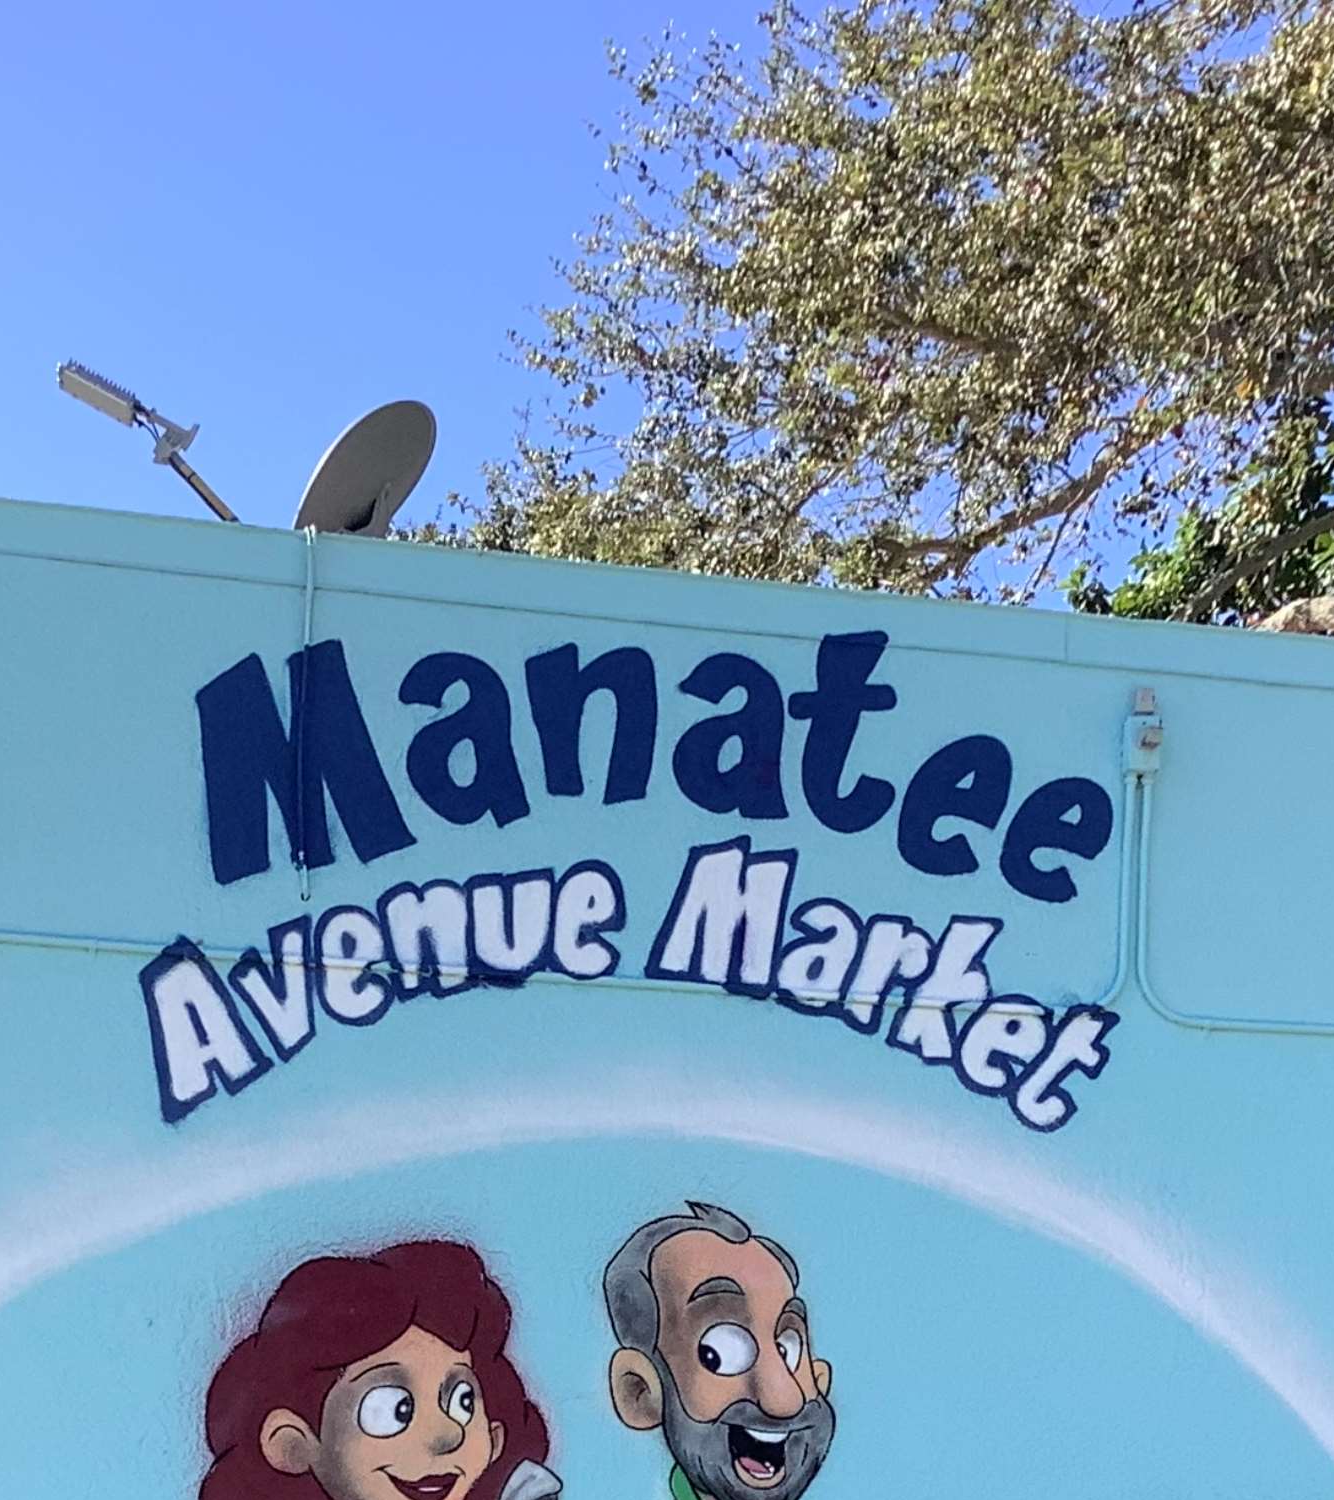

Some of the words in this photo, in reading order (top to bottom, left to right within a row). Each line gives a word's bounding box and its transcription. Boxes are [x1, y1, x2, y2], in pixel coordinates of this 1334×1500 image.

[195, 631, 1114, 902] Manatee
[139, 861, 625, 1124] Avenue
[645, 836, 1121, 1132] Market
